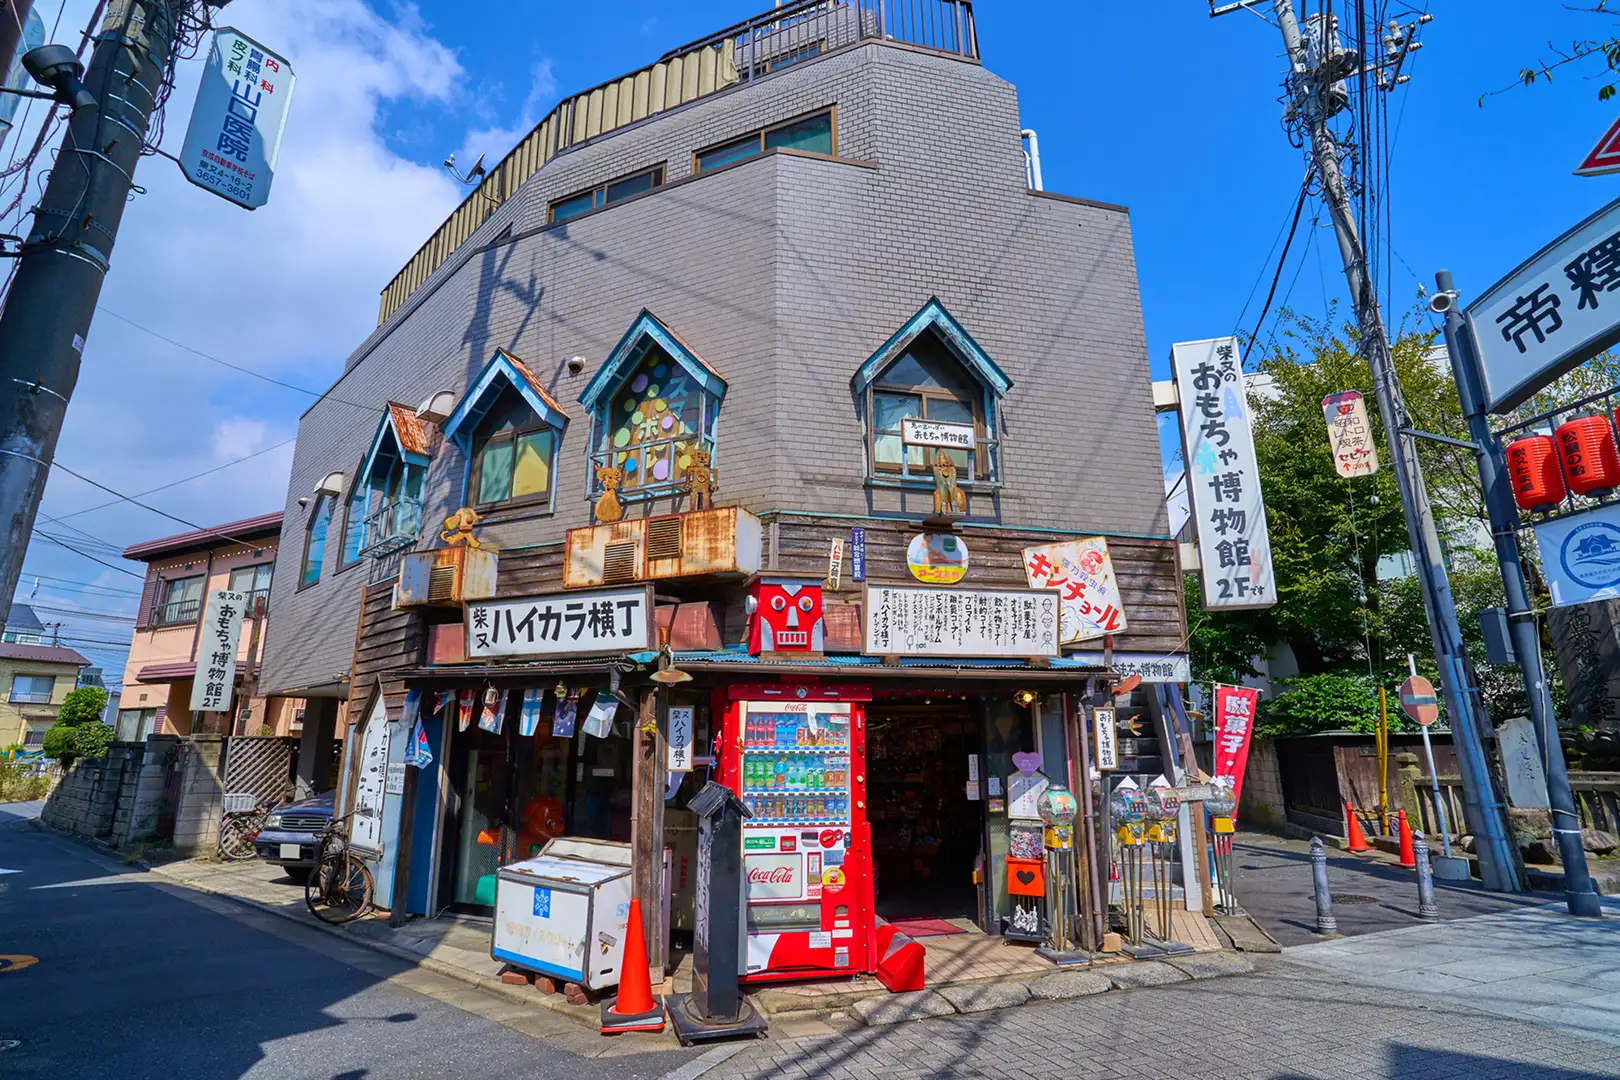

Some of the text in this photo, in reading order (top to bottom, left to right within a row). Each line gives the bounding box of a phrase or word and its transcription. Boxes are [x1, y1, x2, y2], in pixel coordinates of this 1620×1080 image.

[227, 39, 248, 76] 皮フ科
[244, 48, 264, 86] 胃腸科
[260, 58, 280, 95] 内科
[216, 79, 262, 163] 山口医院
[1216, 345, 1237, 383] 柴又の
[914, 430, 969, 444] おもちゃ博物館
[1333, 426, 1365, 438] レトロ
[1190, 361, 1252, 569] おもちゃ博物館
[1338, 448, 1371, 461] セピア
[218, 591, 243, 601] 柴又の
[1028, 552, 1121, 631] キンチョール
[1216, 576, 1265, 599] 2Fです
[472, 607, 490, 650] 柴又
[491, 600, 640, 644] ハイカラ横丁
[881, 590, 891, 648] 柴又ハイカラ横丁
[950, 595, 958, 640] 雑貨コーナー
[964, 596, 973, 633] ブロマイド
[978, 596, 987, 639] 射的コーナー
[994, 596, 1003, 646] 飲み物コーナー
[1023, 600, 1033, 639] 駄菓子屋
[206, 604, 237, 697] おもちゃ博物館
[202, 698, 221, 708] 2F
[672, 710, 690, 720] 柴又
[673, 720, 687, 768] ハイカラ横丁
[1100, 712, 1113, 766] おもちゃ博物館
[747, 866, 795, 884] Coca-Cola
